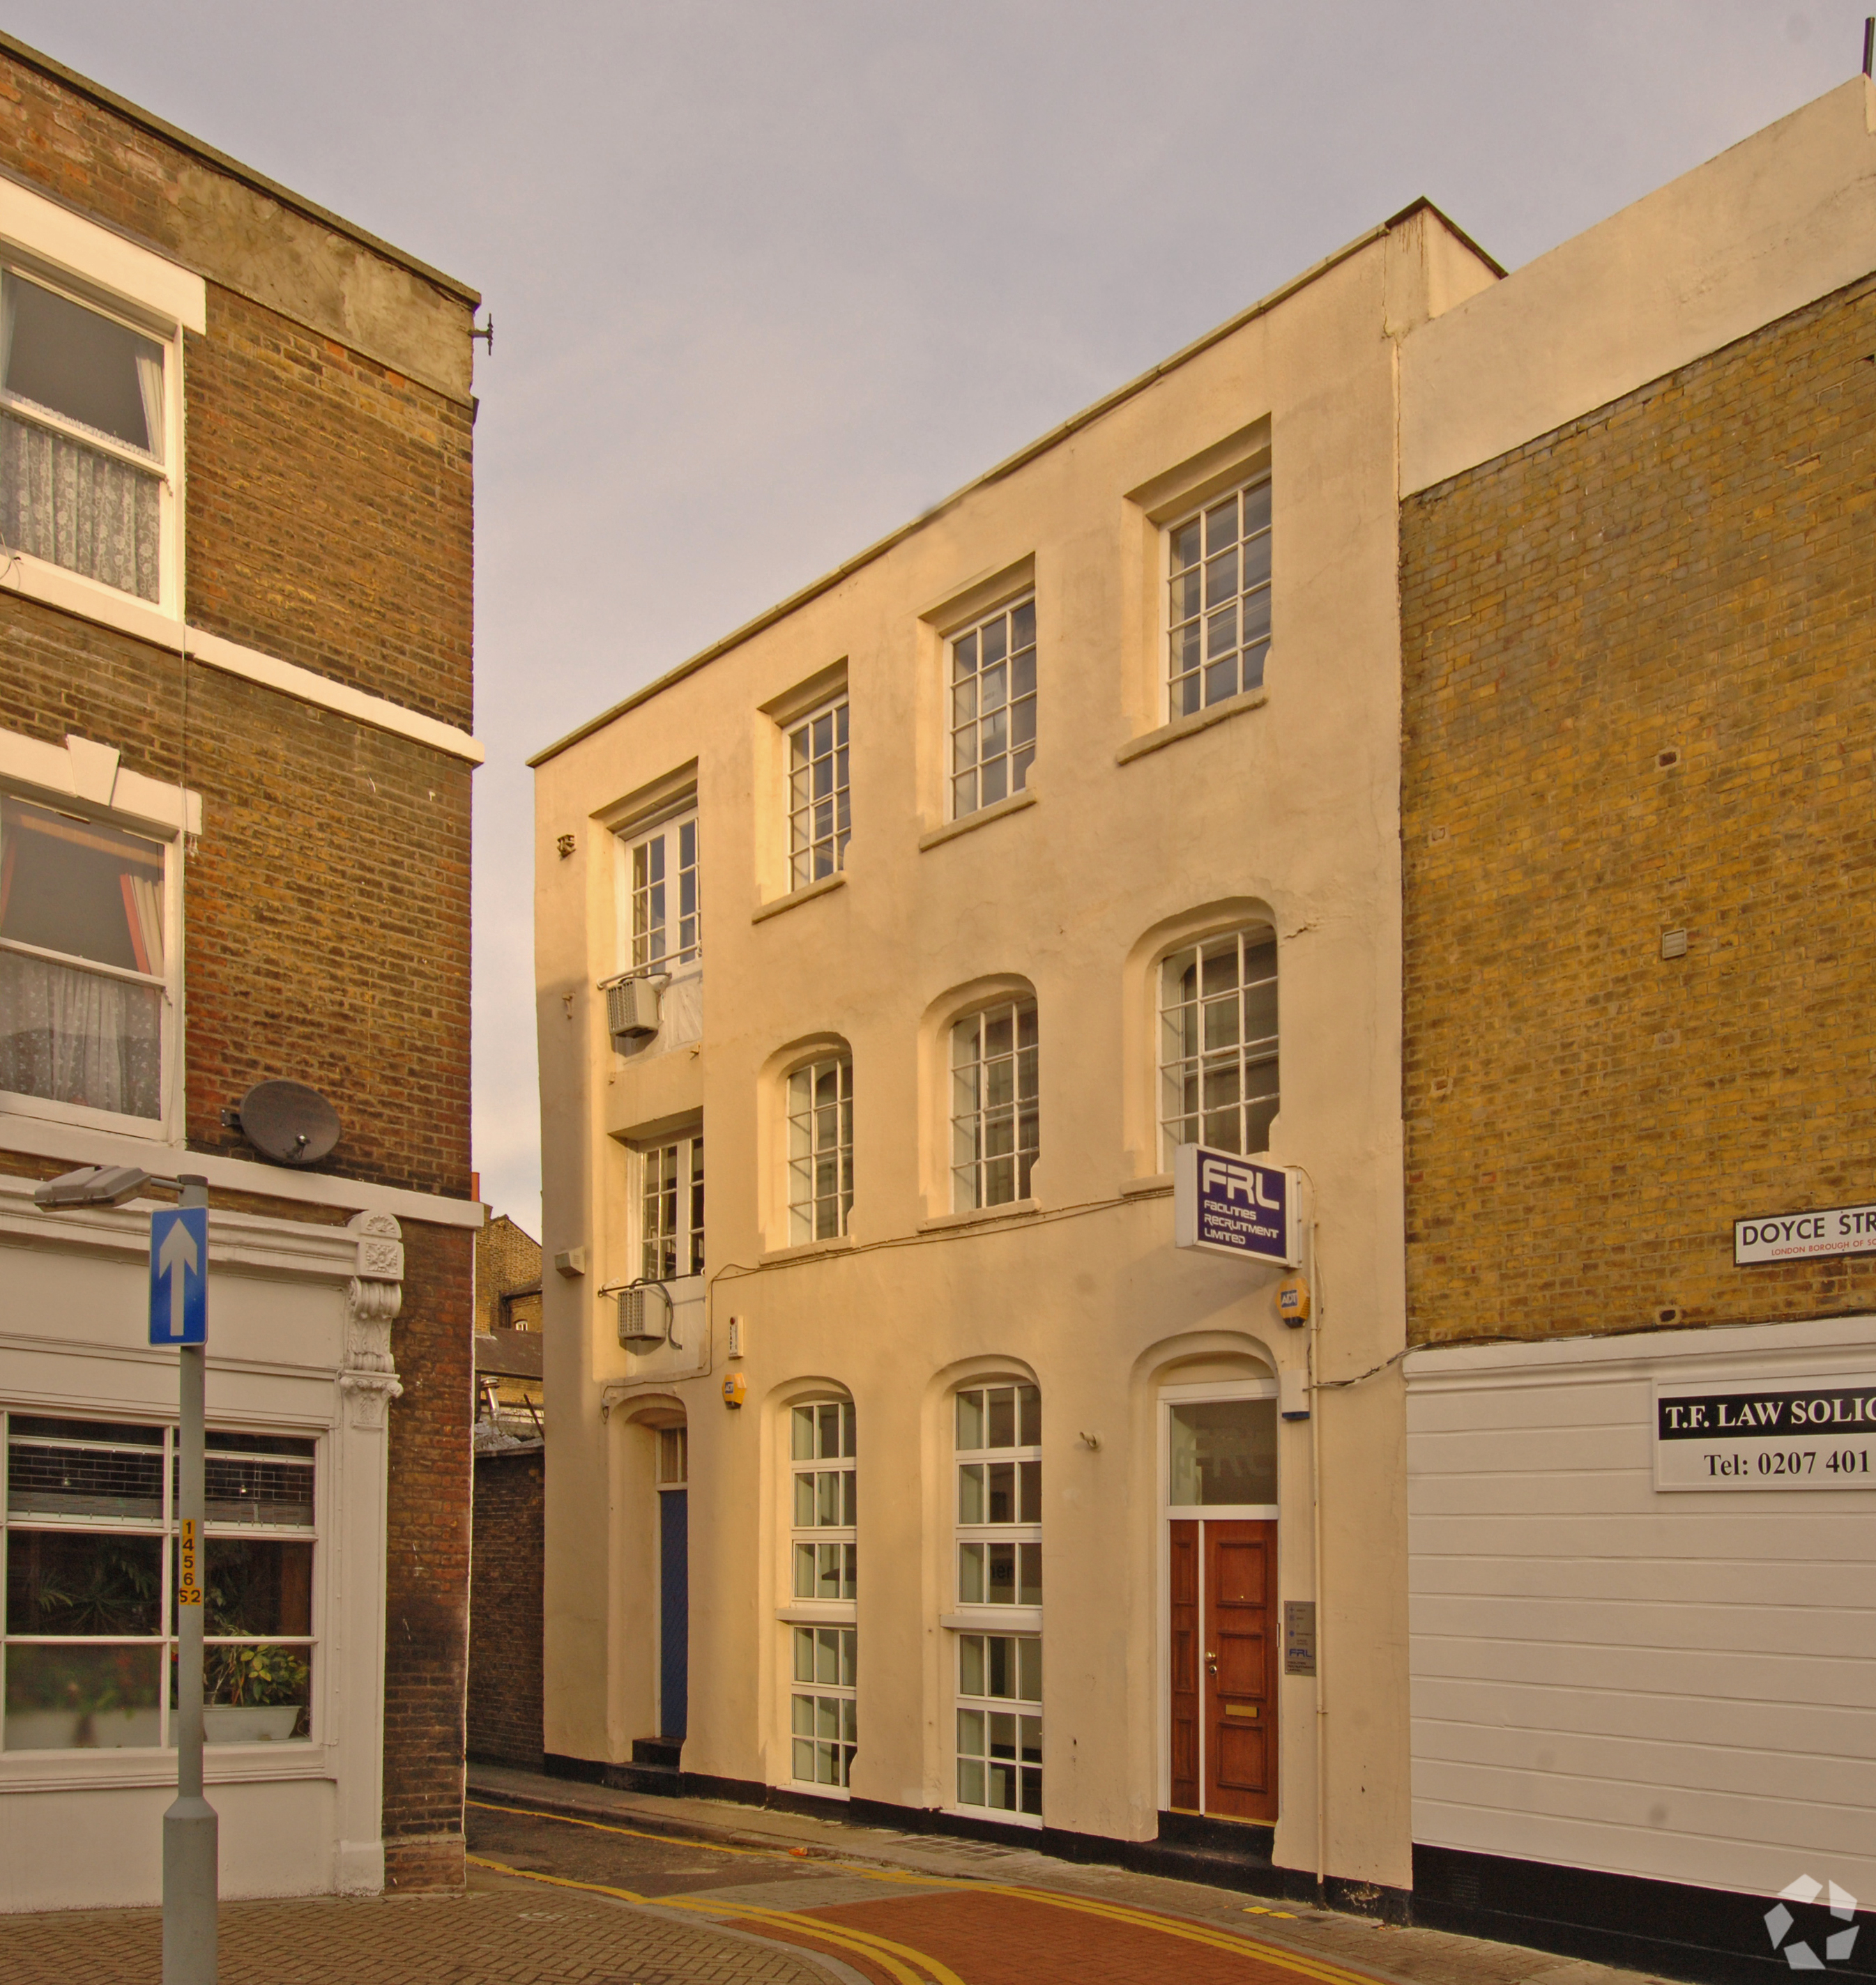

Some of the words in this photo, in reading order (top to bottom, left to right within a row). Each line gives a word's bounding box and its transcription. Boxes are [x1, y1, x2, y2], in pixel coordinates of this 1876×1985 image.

[1203, 1159, 1280, 1210] FRL
[1204, 1228, 1246, 1245] LIMITED
[1743, 1217, 1825, 1246] DOYCE
[1839, 1211, 1876, 1235] STR
[1771, 1246, 1806, 1256] LONDON
[1809, 1241, 1850, 1252] BOROUGH
[1281, 1292, 1297, 1304] ADT
[1665, 1405, 1710, 1429] T.F.
[1717, 1402, 1783, 1427] LAW
[1704, 1454, 1748, 1476] Tel:
[1757, 1451, 1817, 1475] 0207
[1825, 1450, 1870, 1473] 401
